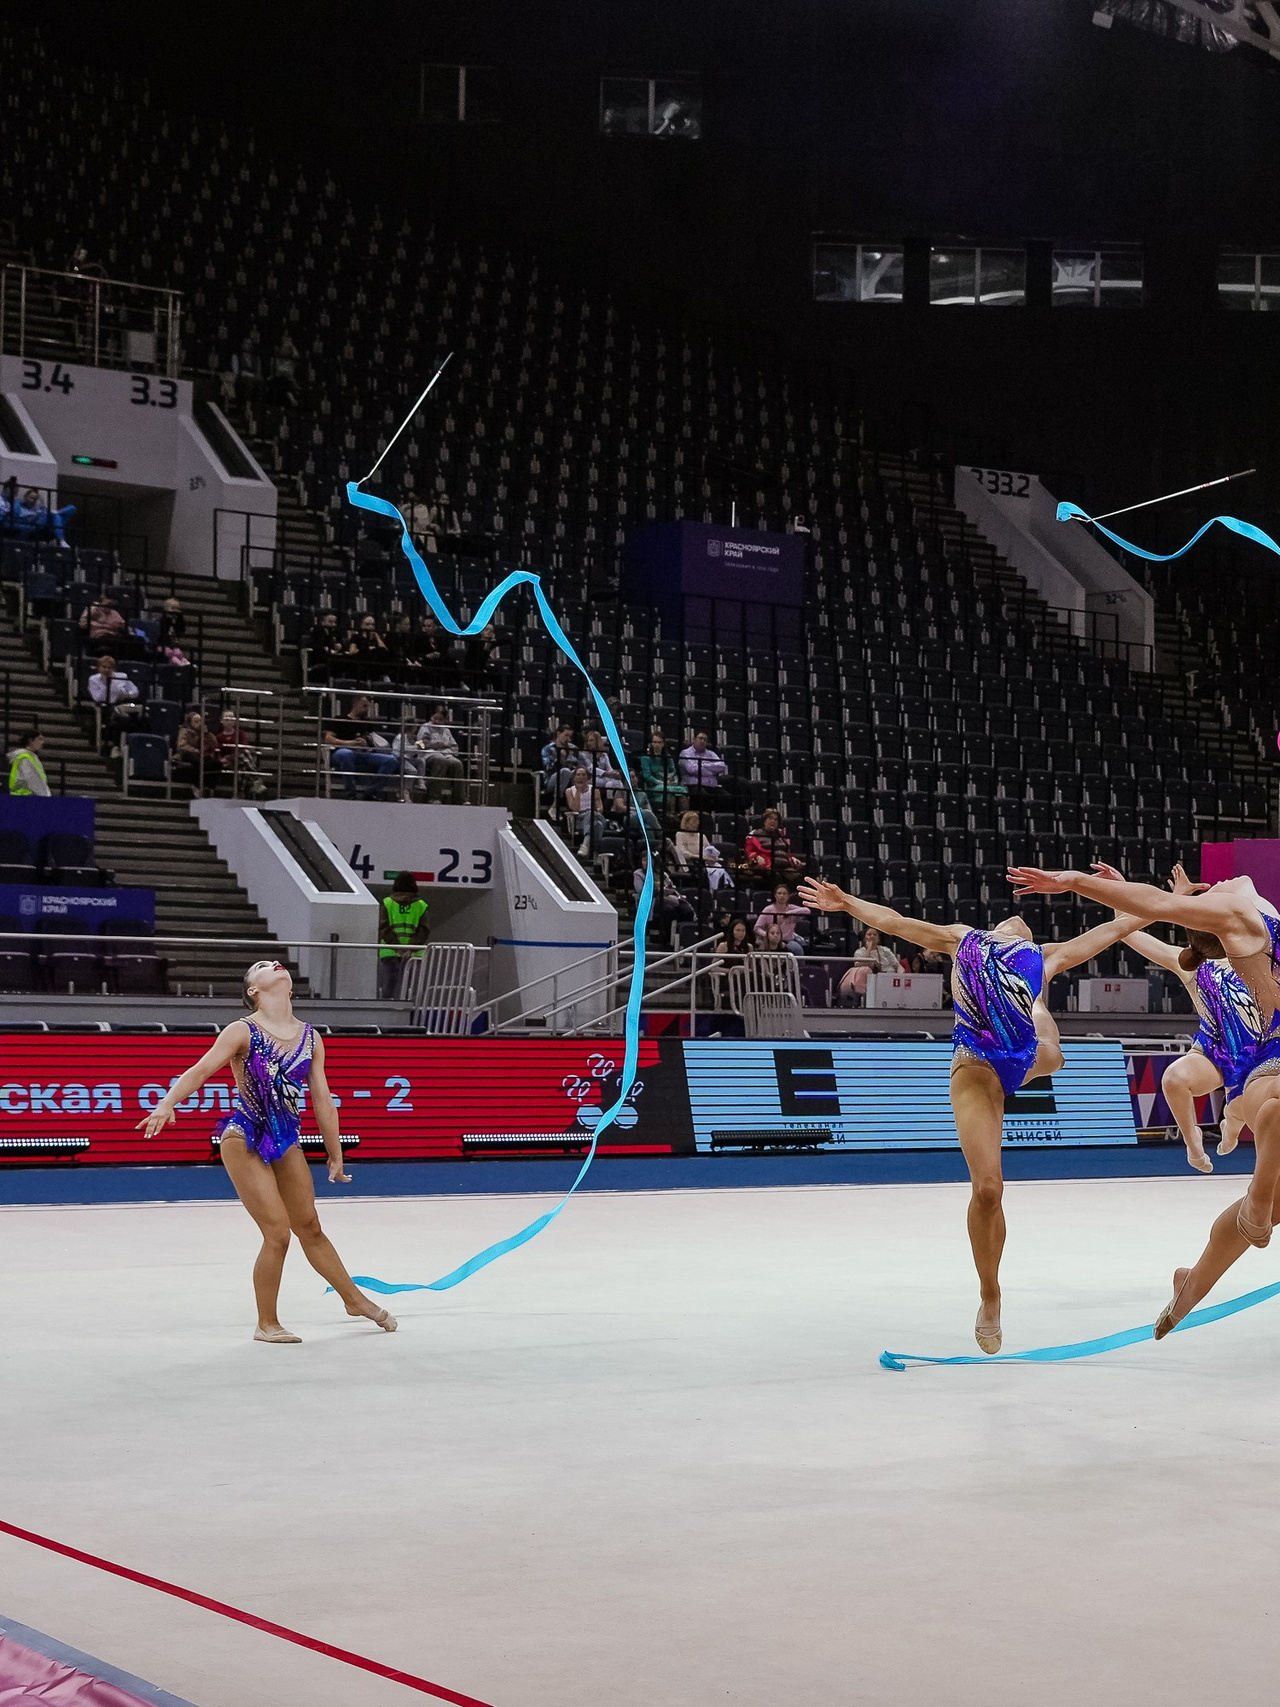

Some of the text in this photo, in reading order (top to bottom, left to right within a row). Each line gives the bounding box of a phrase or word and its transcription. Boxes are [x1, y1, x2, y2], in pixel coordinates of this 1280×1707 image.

[22, 360, 74, 394] 3.4
[130, 375, 178, 409] 3.3
[437, 848, 492, 884] 2.3
